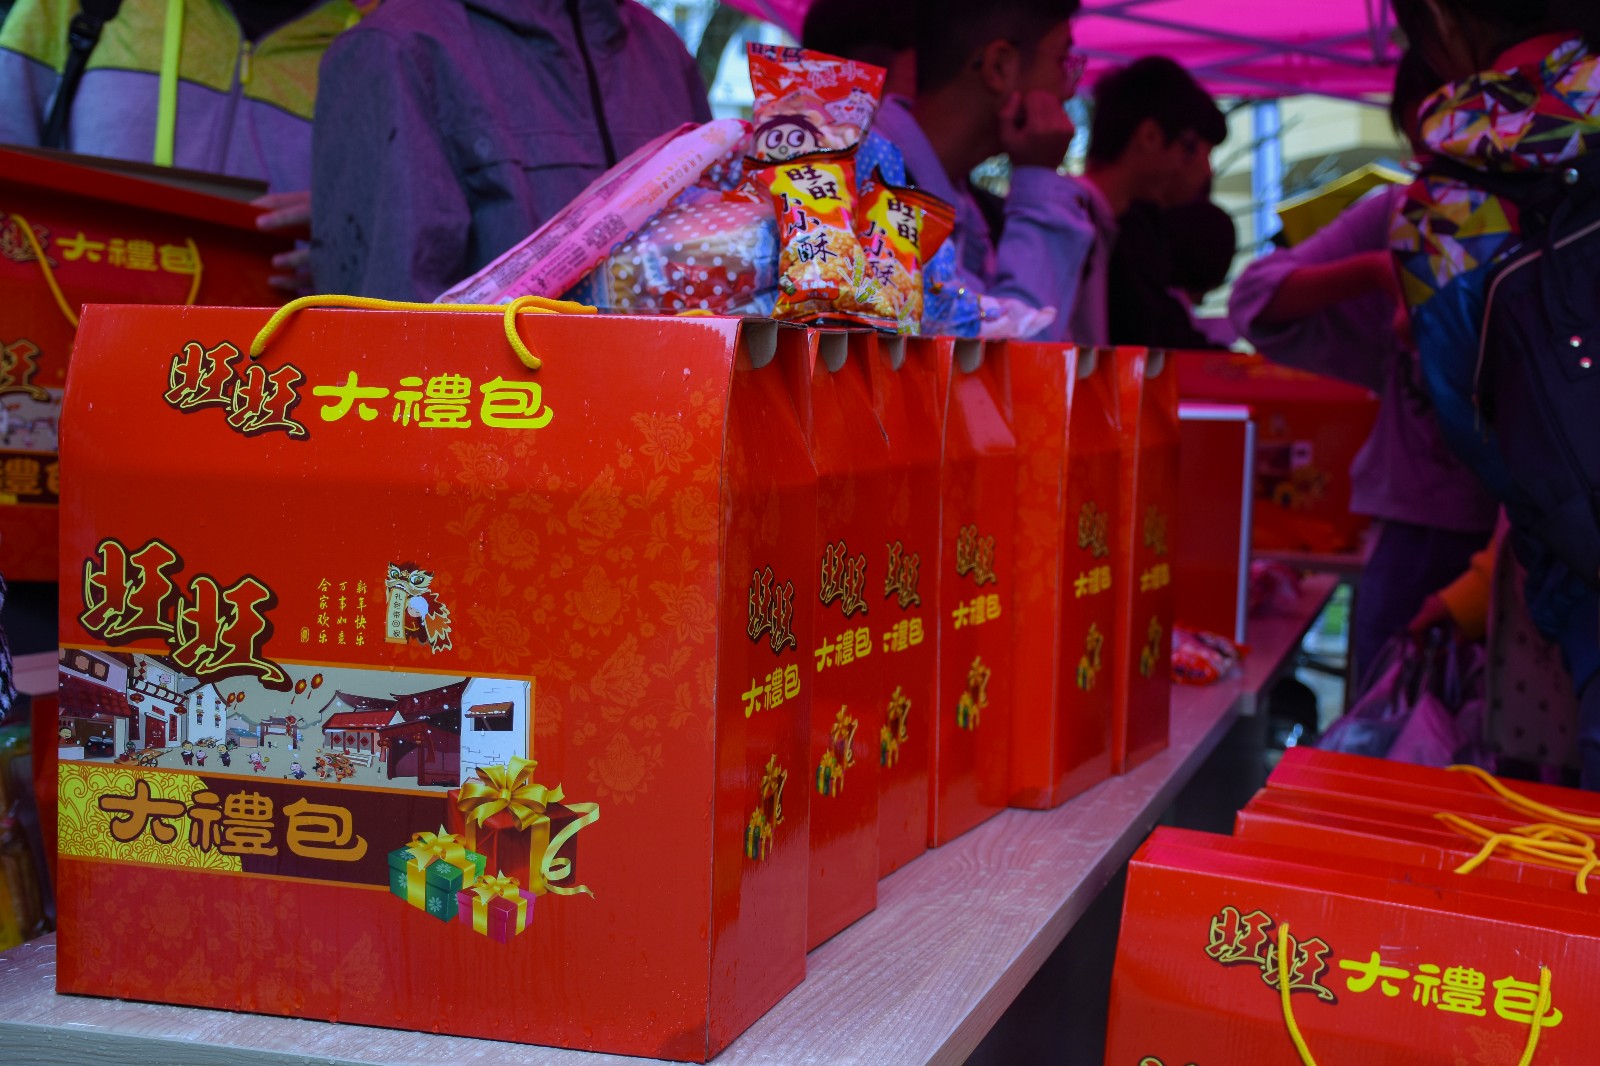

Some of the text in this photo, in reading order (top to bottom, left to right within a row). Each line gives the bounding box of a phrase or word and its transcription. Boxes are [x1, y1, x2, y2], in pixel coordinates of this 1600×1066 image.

[785, 164, 843, 201] 旺旺
[55, 231, 203, 275] 大禮包
[780, 192, 838, 263] 小小酥
[887, 198, 920, 249] 旺旺
[163, 339, 554, 439] 旺旺 大禮包
[78, 538, 290, 688] 旺旺
[317, 577, 332, 644] 合家欢乐
[336, 581, 348, 645] 万事如意
[355, 579, 368, 646] 新年快乐
[815, 627, 872, 672] 大禮包
[741, 663, 801, 718] 大禮包
[100, 780, 368, 862] 大禮包
[1339, 951, 1563, 1028] 大禮包
